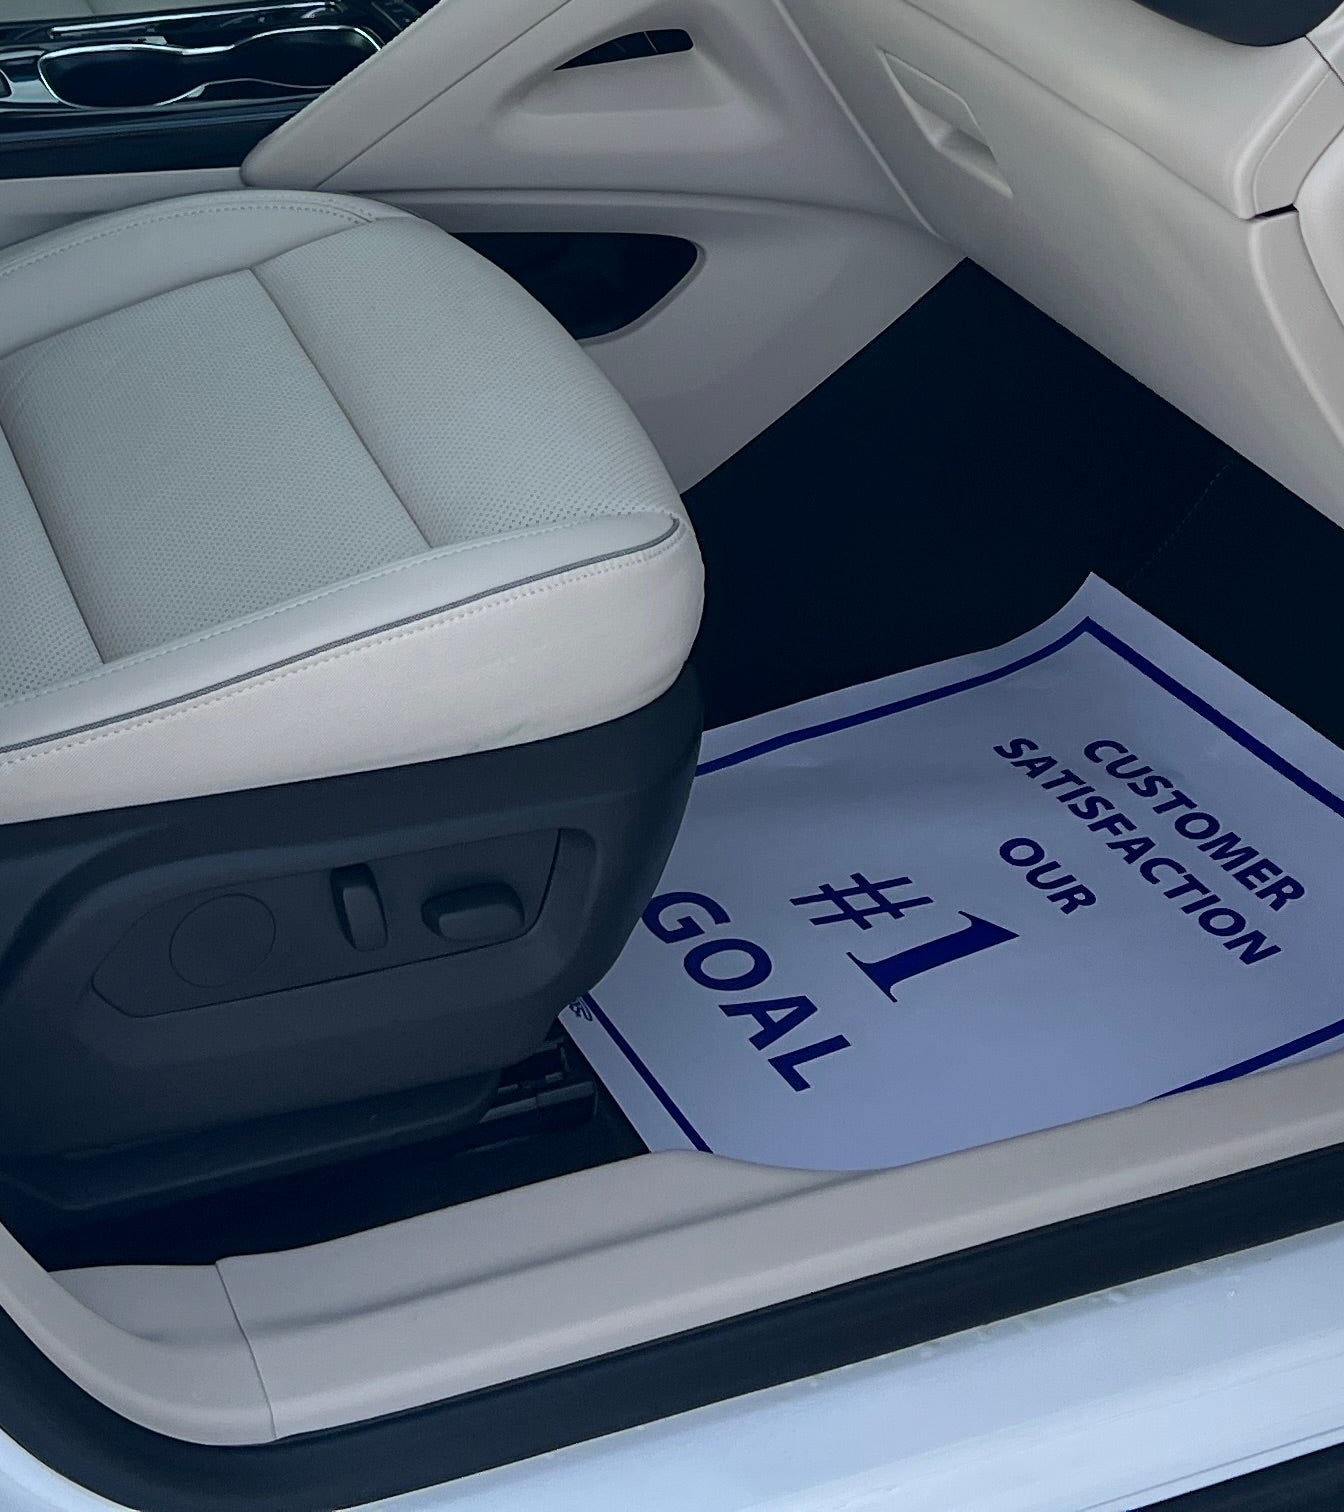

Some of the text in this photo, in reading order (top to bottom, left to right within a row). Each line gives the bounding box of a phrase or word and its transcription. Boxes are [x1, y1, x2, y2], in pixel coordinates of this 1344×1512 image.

[992, 736, 1282, 966] SATISFACTION
[998, 837, 1098, 916] OUR
[1083, 738, 1306, 913] CUSTOMER
[642, 891, 853, 1093] GOAL
[789, 872, 1020, 1003] #1
